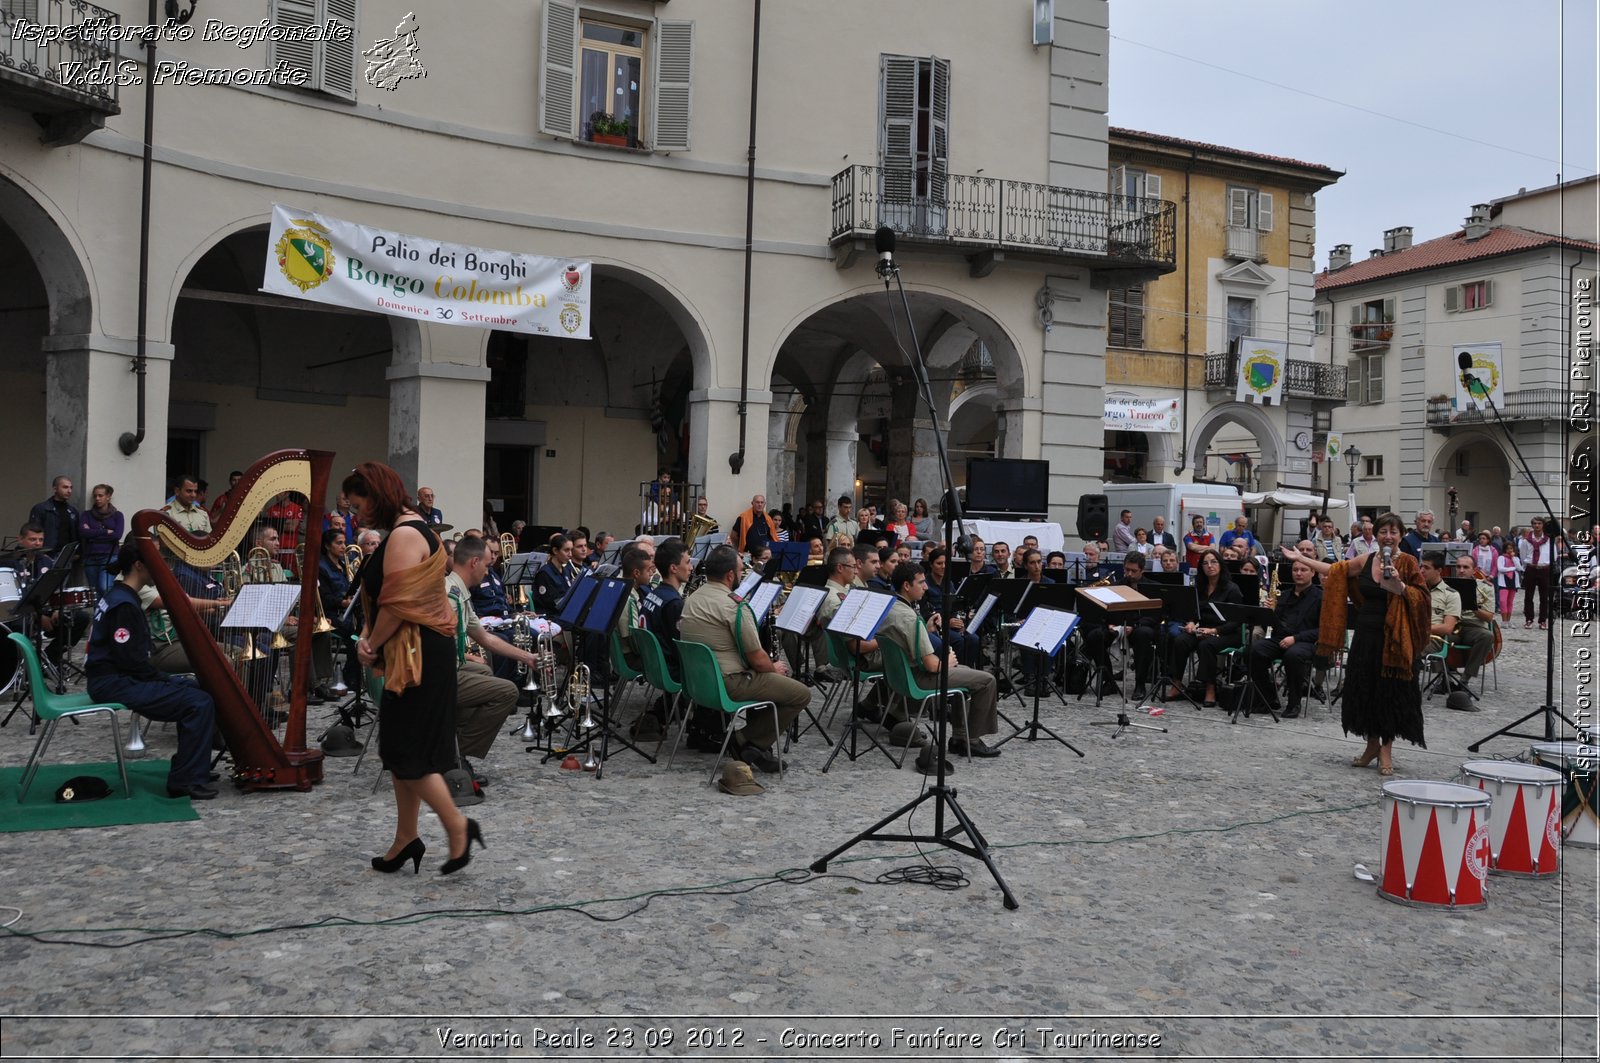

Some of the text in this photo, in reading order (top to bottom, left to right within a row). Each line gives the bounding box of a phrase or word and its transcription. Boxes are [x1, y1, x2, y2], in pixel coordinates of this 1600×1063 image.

[372, 236, 527, 281] Palio dei Borghi
[346, 256, 548, 309] Borgo Colomba
[376, 297, 518, 327] Domenica 30 Settembre
[1128, 408, 1164, 420] Trucco
